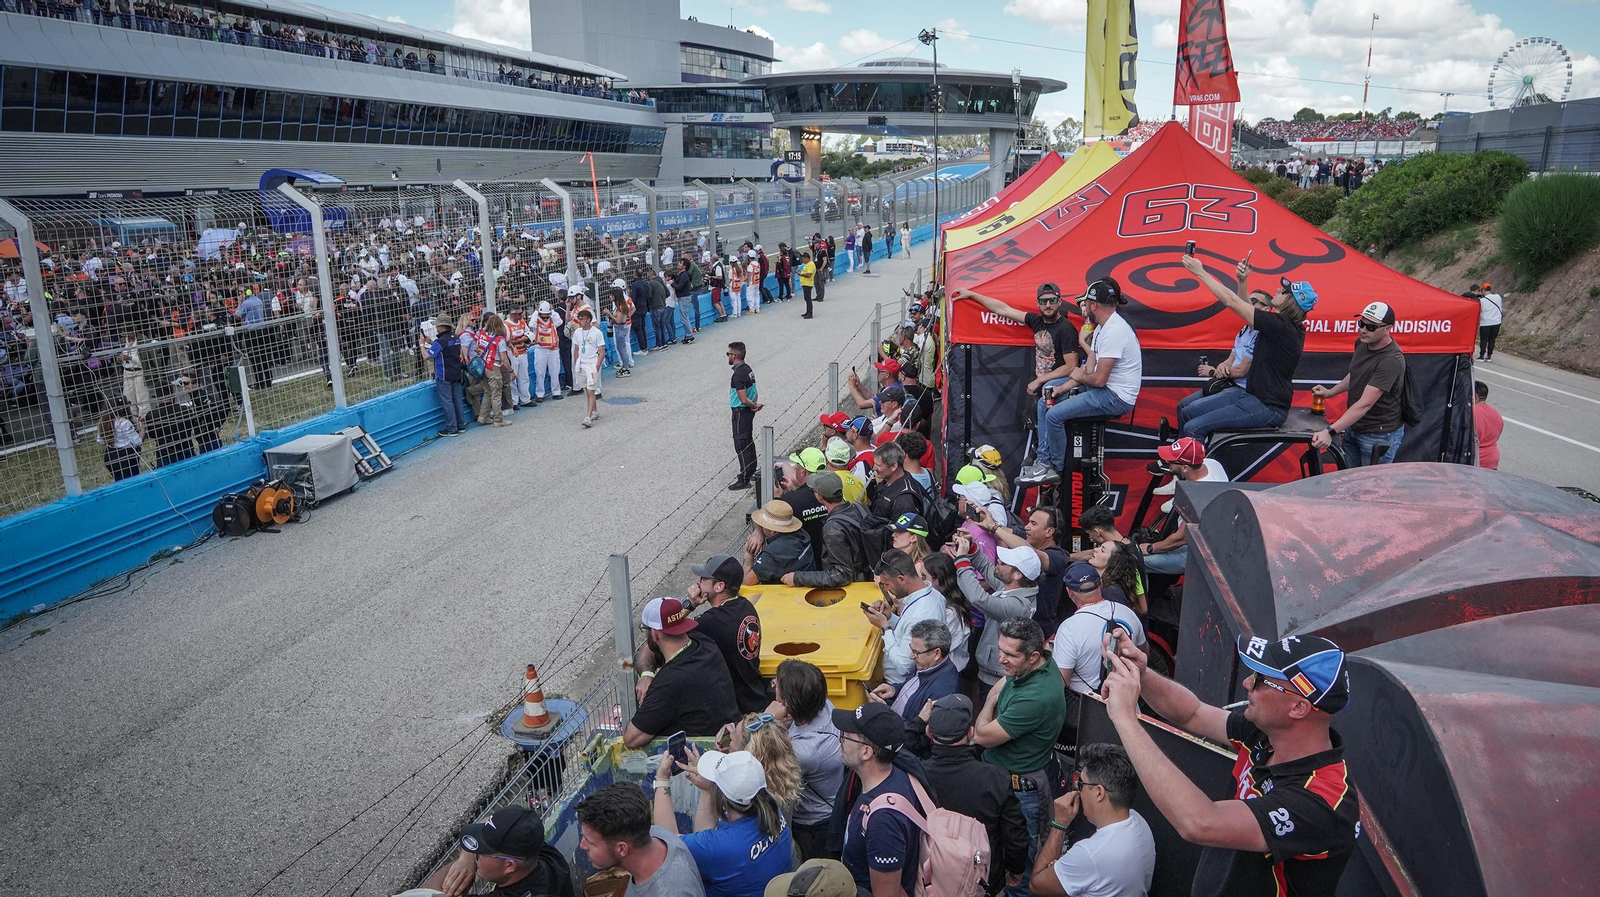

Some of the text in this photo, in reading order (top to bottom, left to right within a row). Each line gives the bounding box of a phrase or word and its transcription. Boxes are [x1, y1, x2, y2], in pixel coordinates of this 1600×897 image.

[787, 152, 802, 160] 17:15
[1117, 183, 1257, 238] 63
[1303, 320, 1331, 332] CIAL
[1334, 320, 1451, 333] MENDISING
[1071, 472, 1084, 529] MANITOU
[1268, 807, 1295, 837] 23
